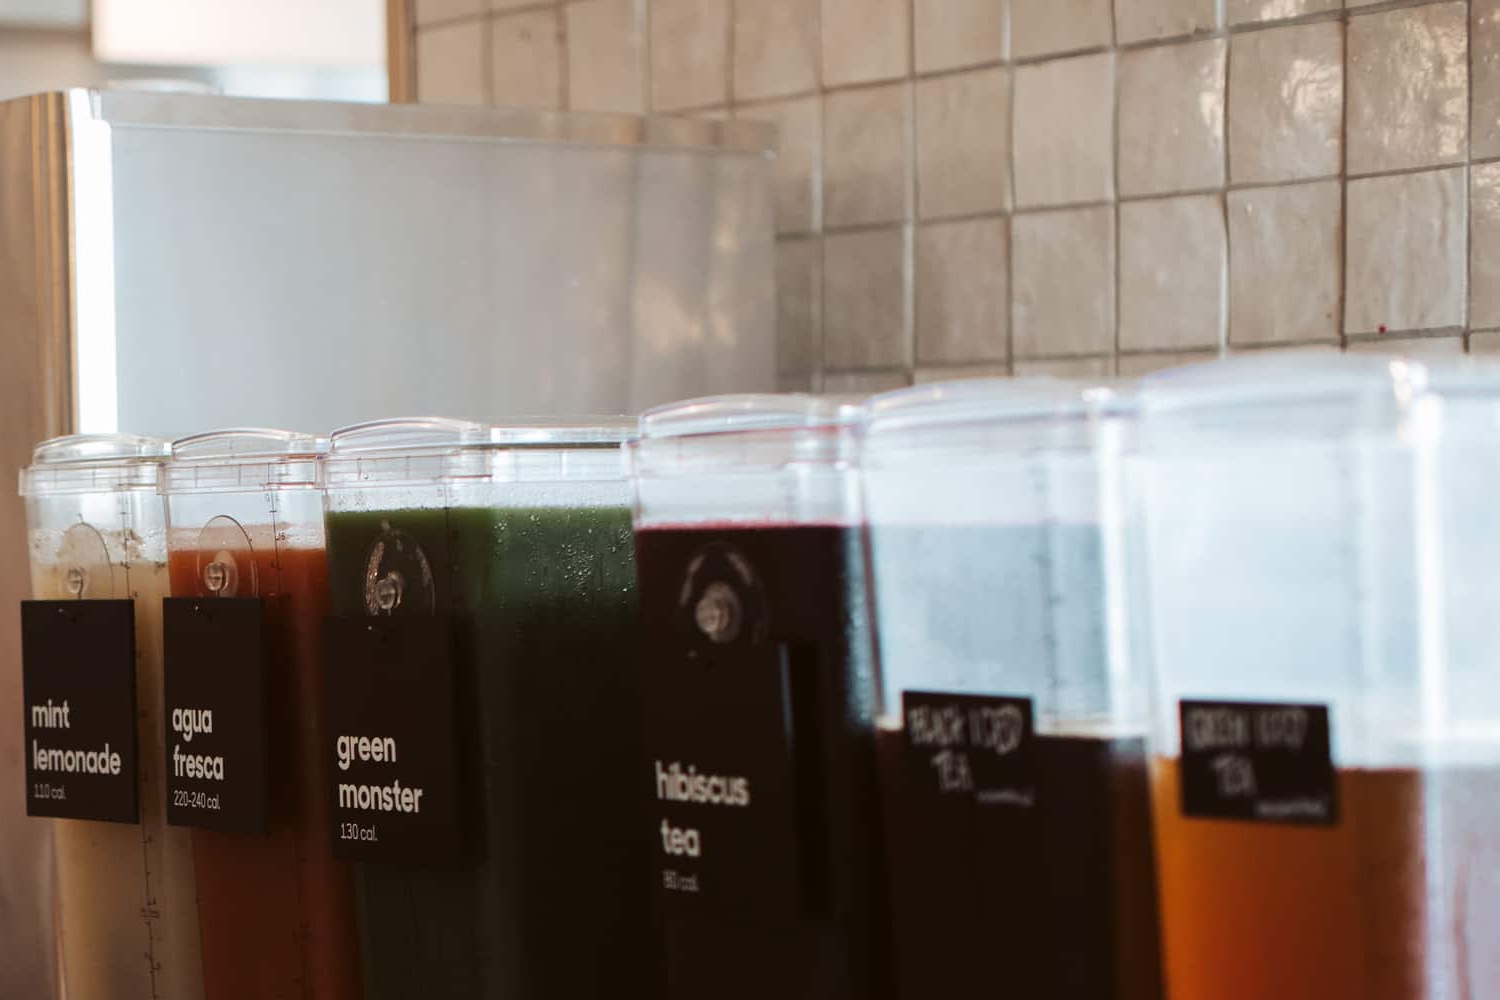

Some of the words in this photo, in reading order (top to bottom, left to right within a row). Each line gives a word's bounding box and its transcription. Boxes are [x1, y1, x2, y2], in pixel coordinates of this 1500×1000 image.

[32, 699, 70, 729] mint
[172, 705, 213, 742] agua
[32, 740, 122, 775] lemonade
[173, 744, 224, 780] fresca
[336, 734, 397, 770] green
[34, 783, 50, 799] 110
[173, 789, 206, 809] 220-240
[206, 793, 221, 810] cal.
[338, 779, 423, 813] monster
[655, 760, 750, 806] hibiscus
[340, 822, 359, 840] 130
[360, 824, 379, 842] cal.
[660, 817, 701, 858] tea
